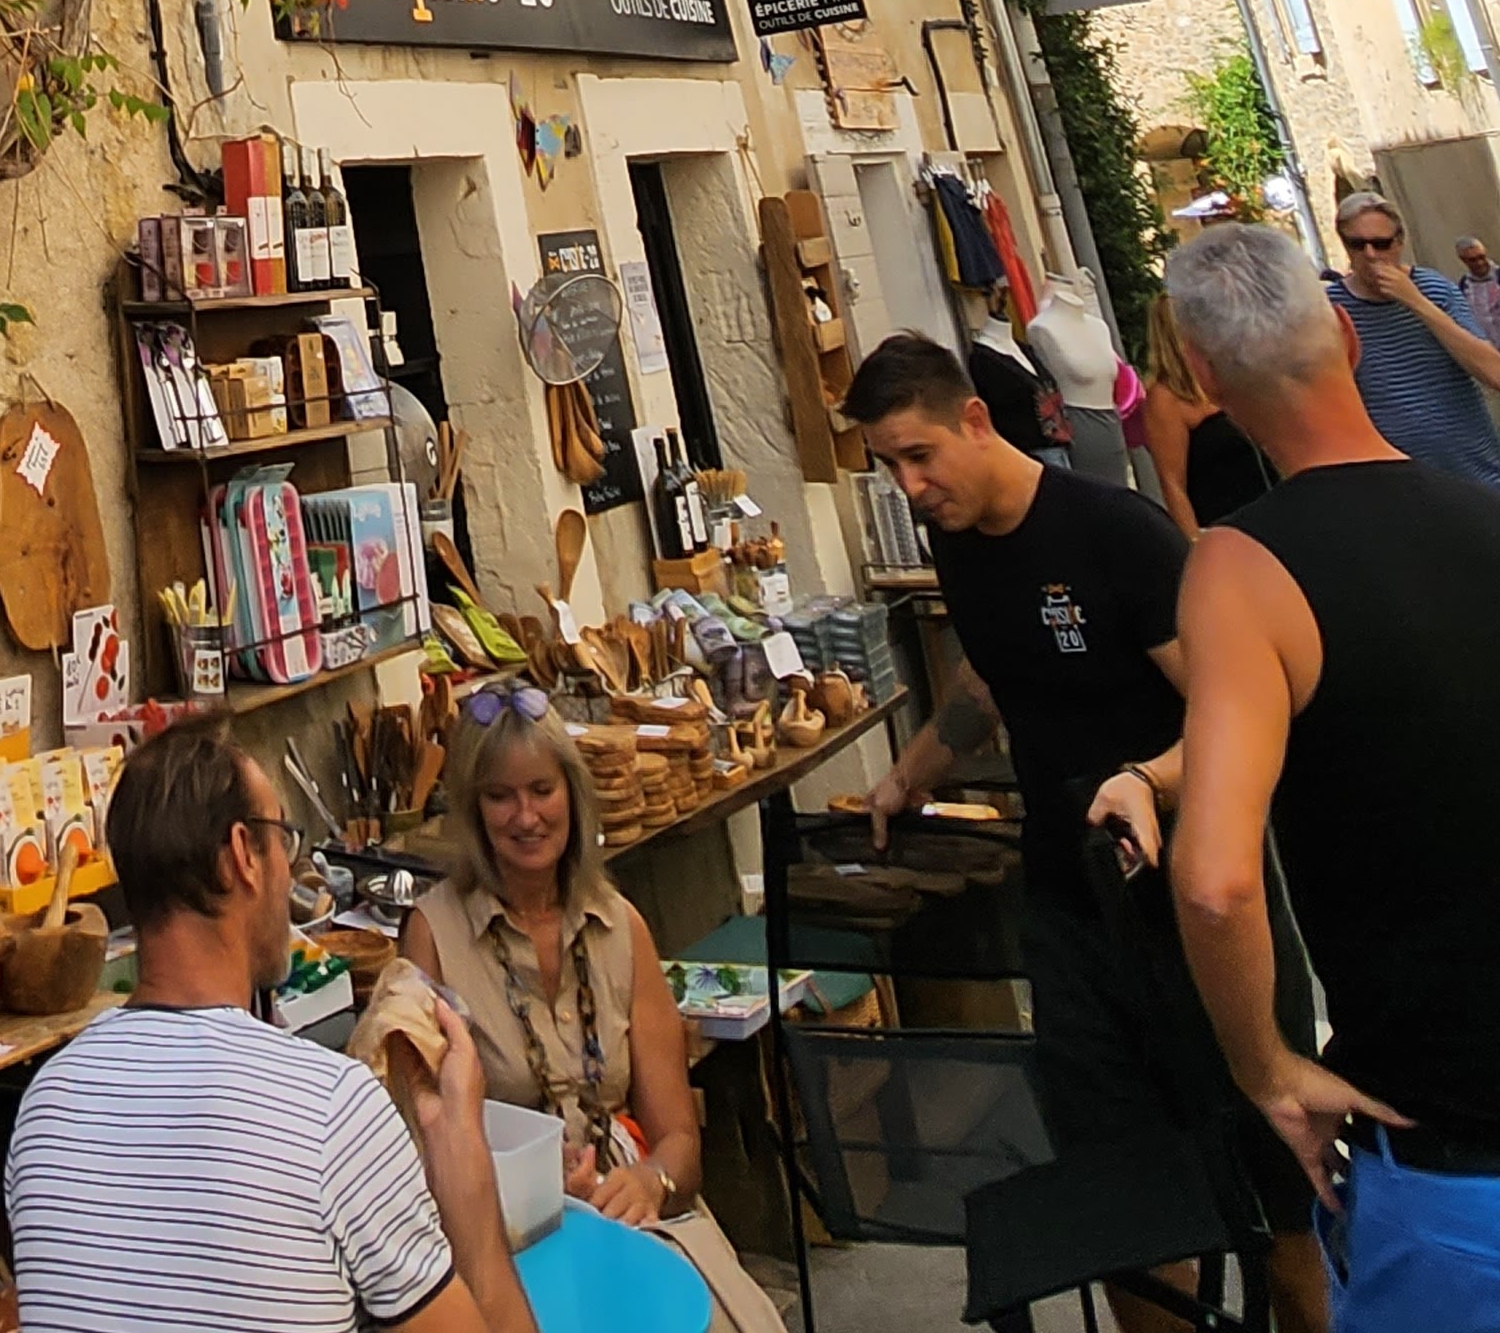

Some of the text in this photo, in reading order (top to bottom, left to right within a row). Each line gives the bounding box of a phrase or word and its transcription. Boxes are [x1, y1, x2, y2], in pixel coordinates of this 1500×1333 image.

[759, 2, 860, 30] OUTILS DE CUISINE
[1060, 630, 1080, 647] 20
